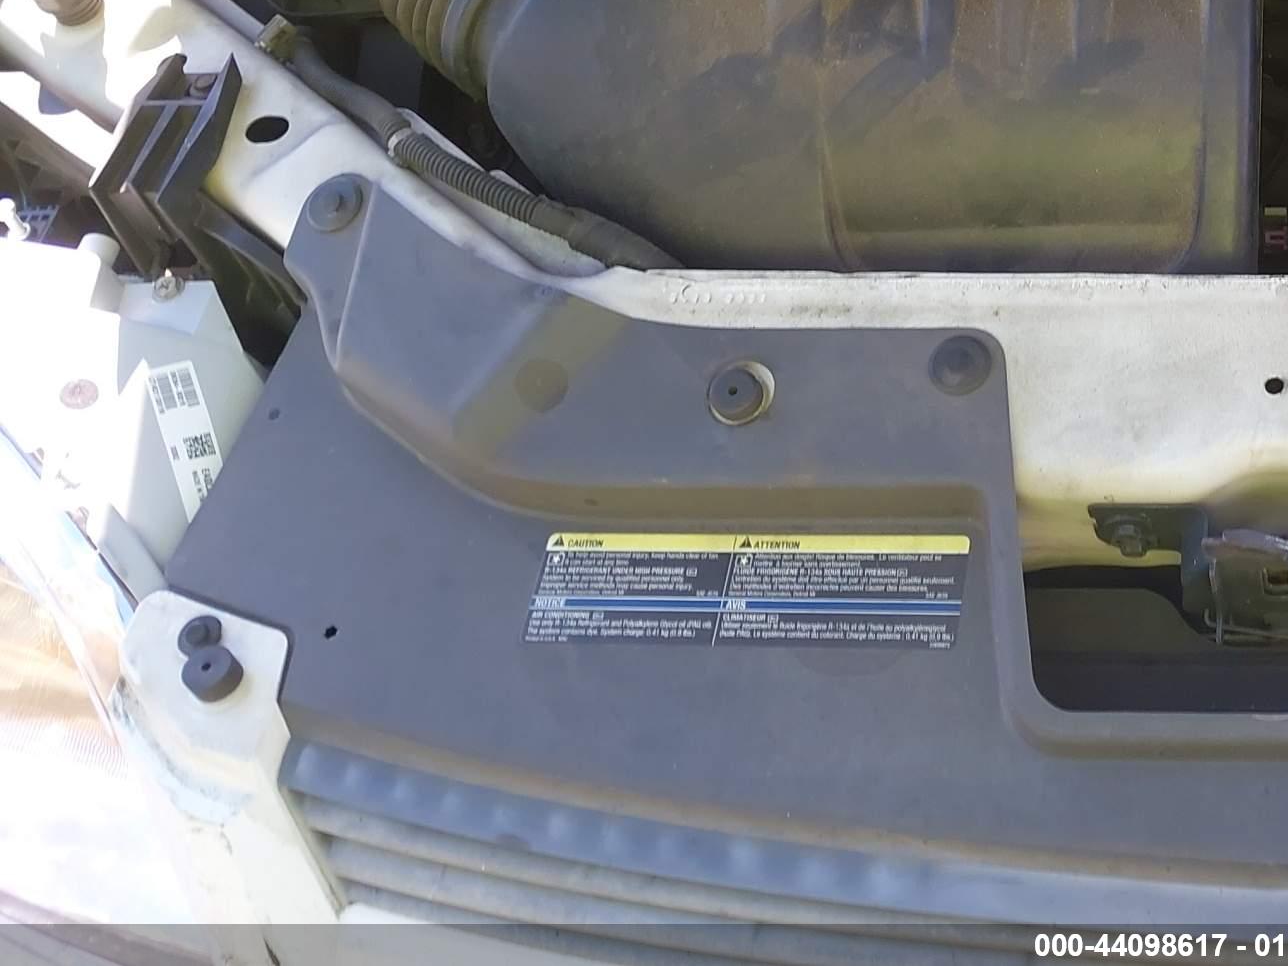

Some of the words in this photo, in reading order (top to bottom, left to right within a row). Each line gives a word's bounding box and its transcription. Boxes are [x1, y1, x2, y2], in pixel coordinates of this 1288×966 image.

[567, 539, 604, 547] CAUTION
[753, 541, 800, 549] ATTENTION
[535, 598, 564, 607] NOTICE
[726, 600, 746, 610] AVIS
